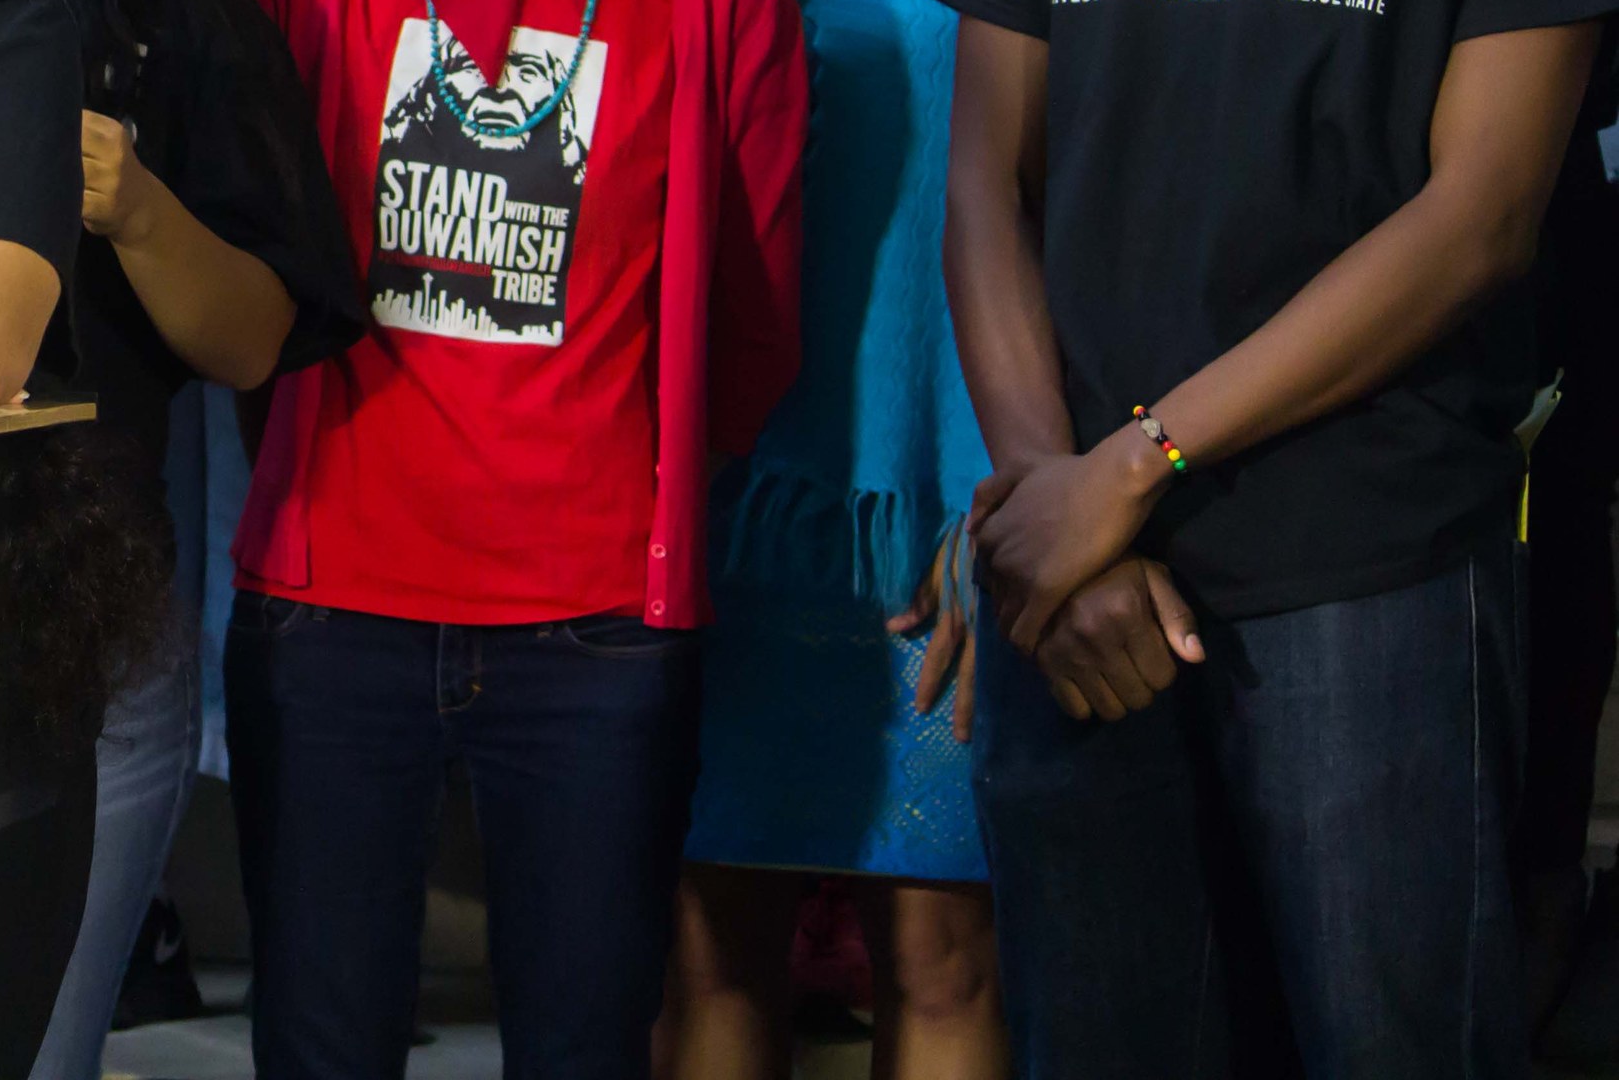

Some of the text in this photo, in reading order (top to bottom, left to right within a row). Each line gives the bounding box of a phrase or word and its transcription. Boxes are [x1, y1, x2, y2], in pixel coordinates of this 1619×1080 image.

[380, 159, 570, 228] STAND WITH THE
[379, 206, 566, 274] DUWAMISH
[491, 268, 558, 306] TRIBE
